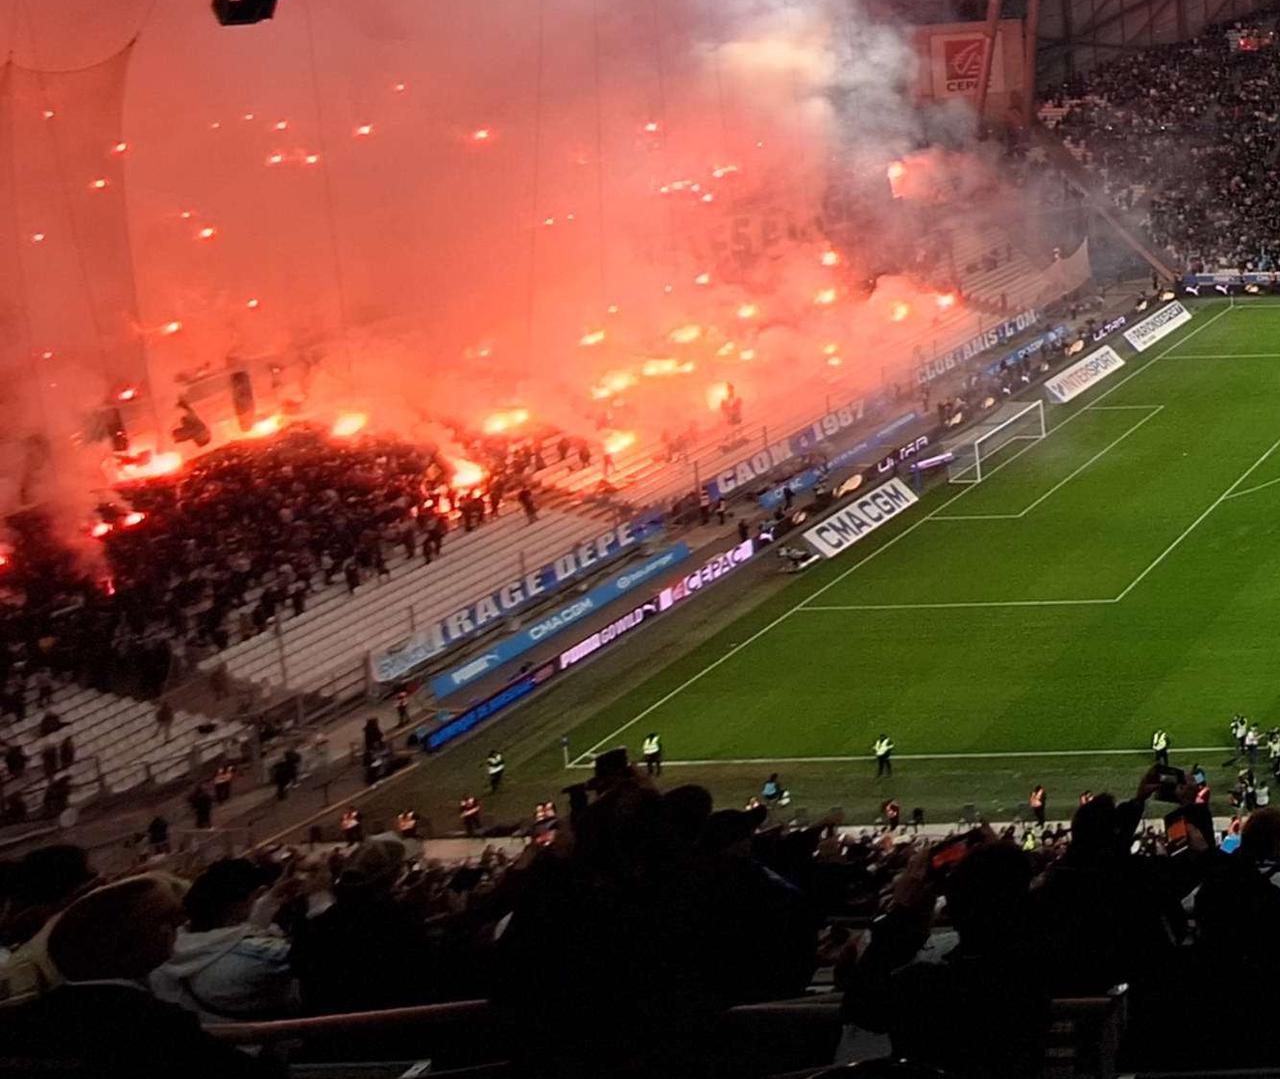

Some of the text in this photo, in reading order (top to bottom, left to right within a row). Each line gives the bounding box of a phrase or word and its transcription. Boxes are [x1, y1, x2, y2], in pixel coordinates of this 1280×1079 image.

[946, 80, 993, 93] CEPA
[1093, 316, 1127, 341] ULTRA
[1061, 346, 1118, 395] INTERSPORT
[716, 440, 794, 493] CAOM
[813, 398, 865, 442] 1987
[877, 435, 929, 473] ULTRA
[816, 483, 911, 549] CMA CGM
[684, 544, 746, 591] CEPAC
